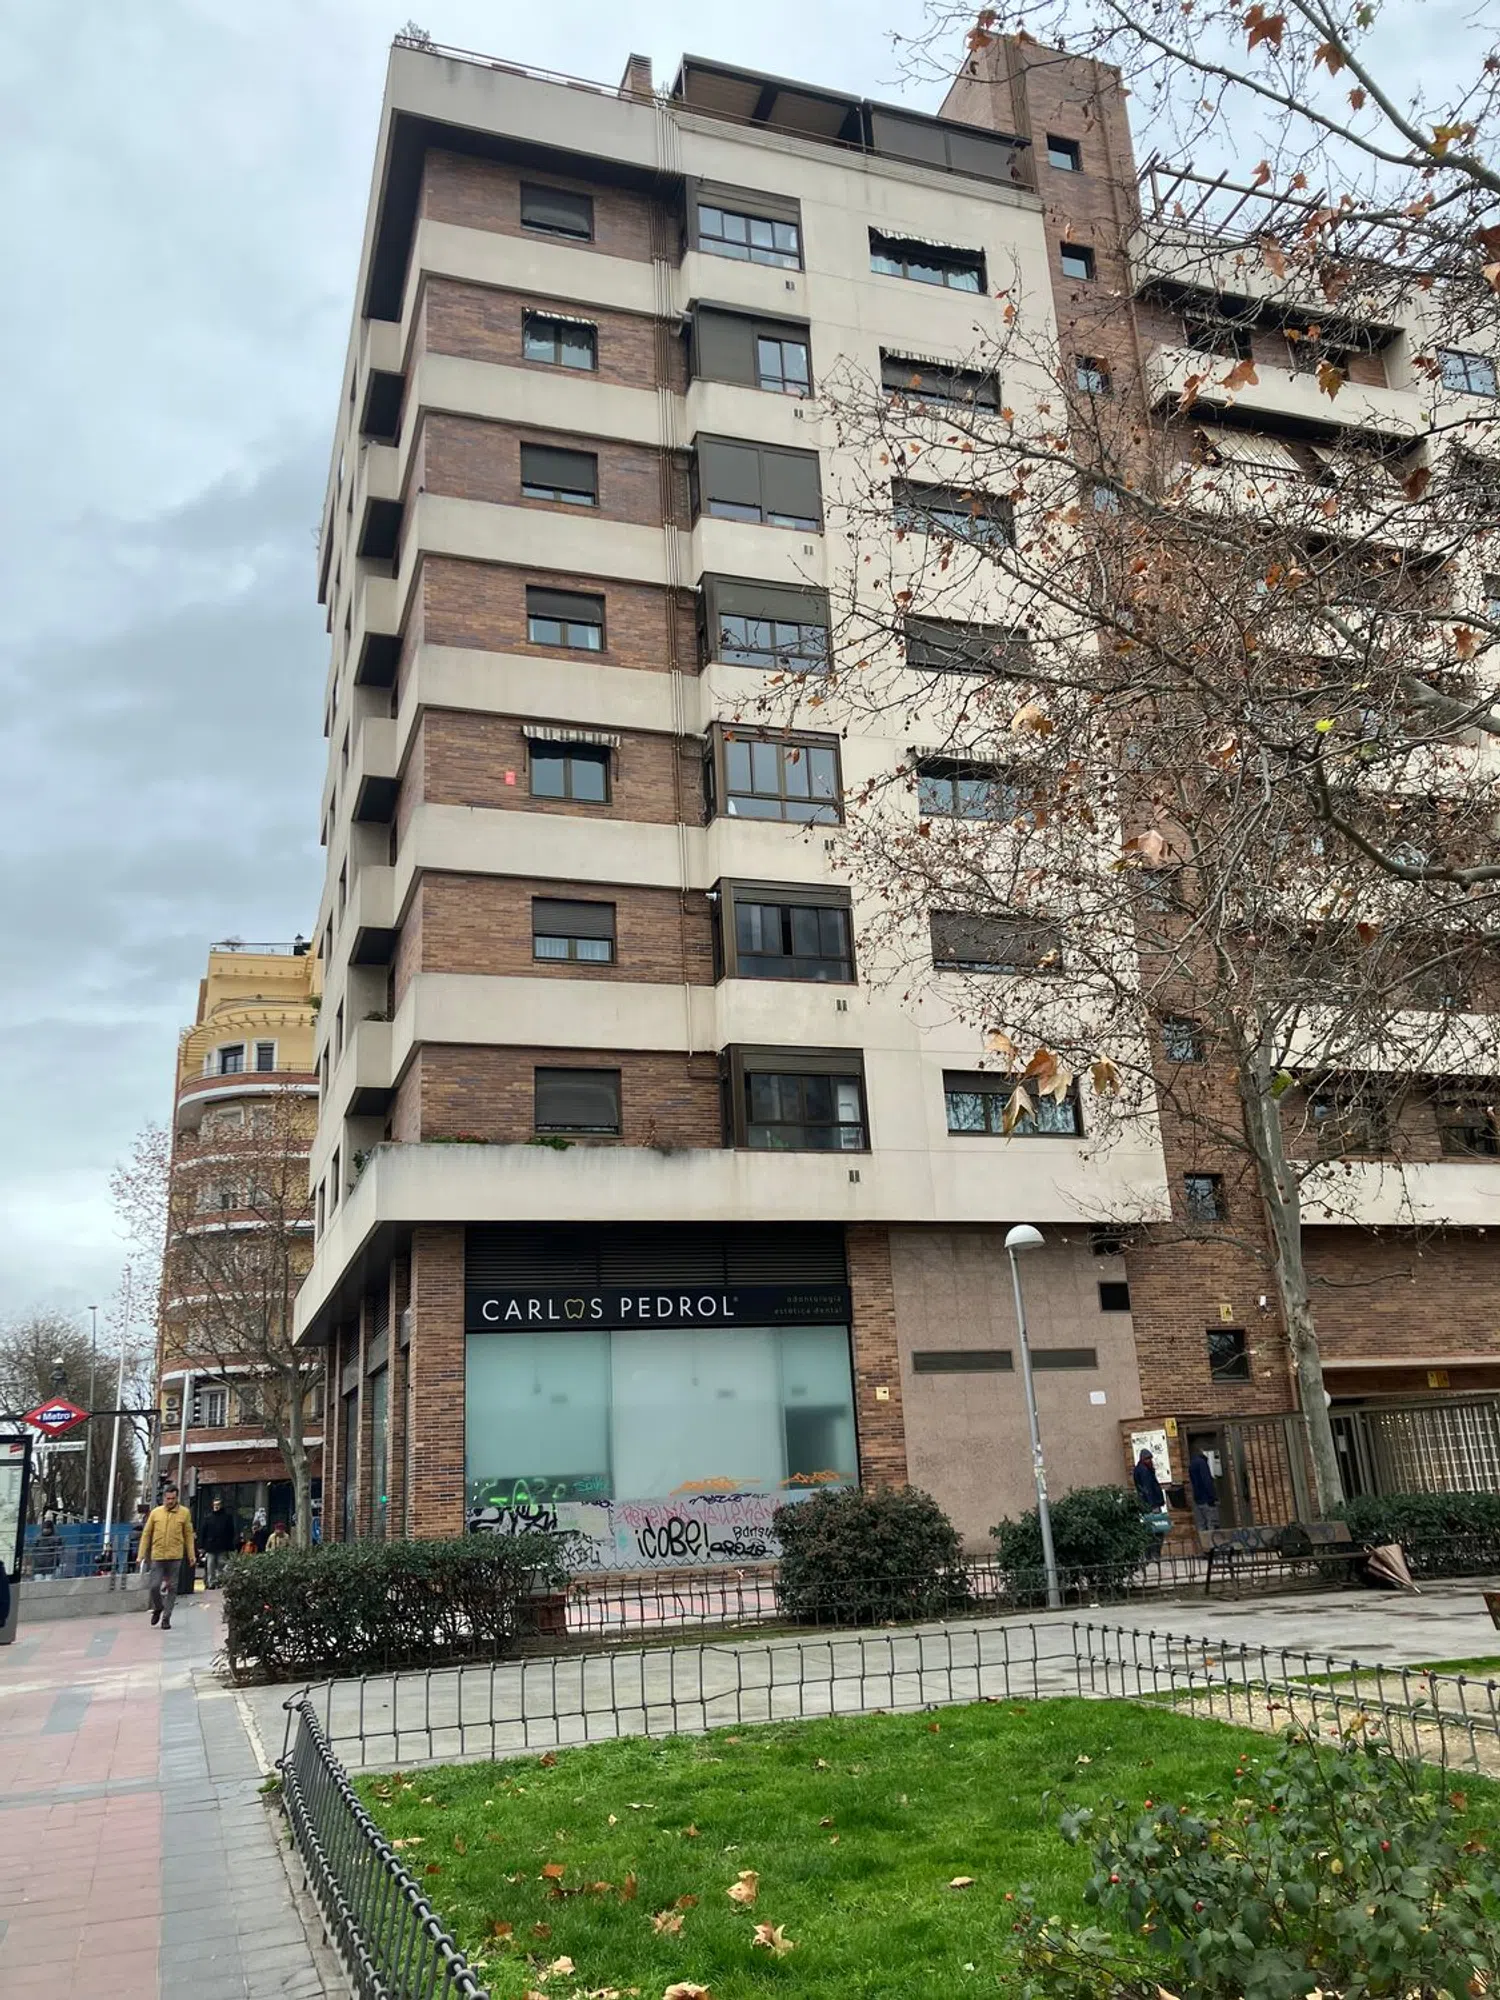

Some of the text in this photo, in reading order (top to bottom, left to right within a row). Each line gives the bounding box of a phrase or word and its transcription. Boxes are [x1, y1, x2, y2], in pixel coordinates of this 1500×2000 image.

[482, 1296, 735, 1321] CARLOS PEDROL
[42, 1412, 70, 1421] Metro
